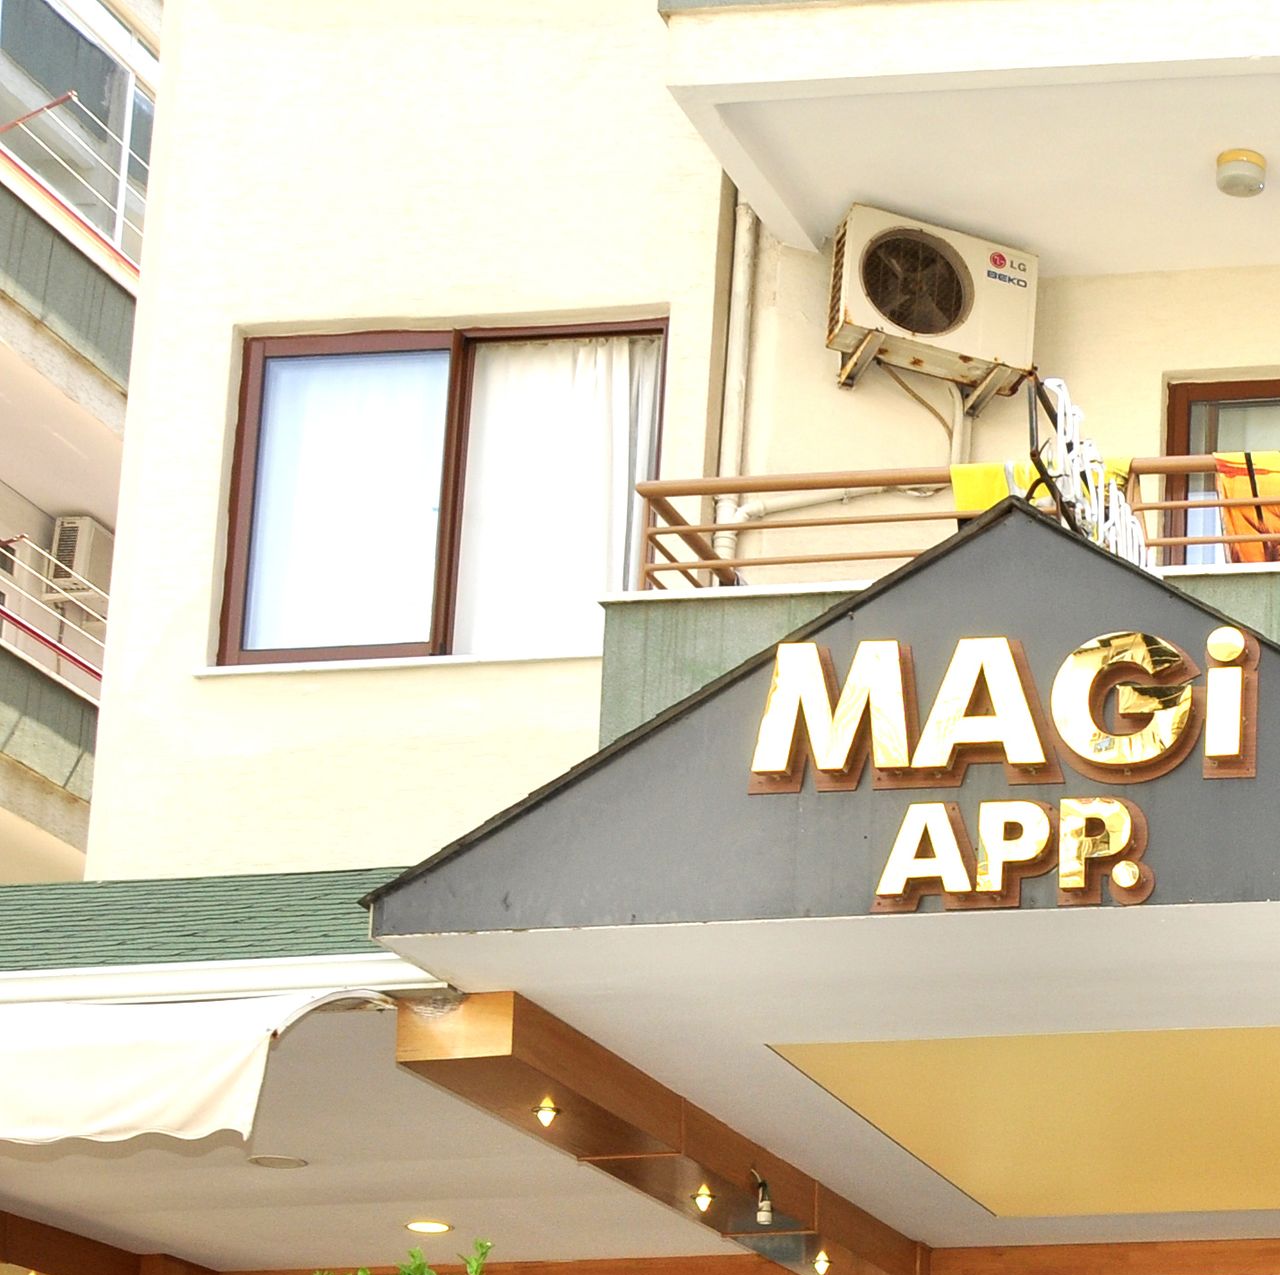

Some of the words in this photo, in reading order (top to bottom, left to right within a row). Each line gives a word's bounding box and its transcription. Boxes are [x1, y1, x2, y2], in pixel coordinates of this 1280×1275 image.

[1010, 260, 1027, 272] LG
[987, 270, 1027, 288] BEKO
[875, 796, 1148, 904] APP.
